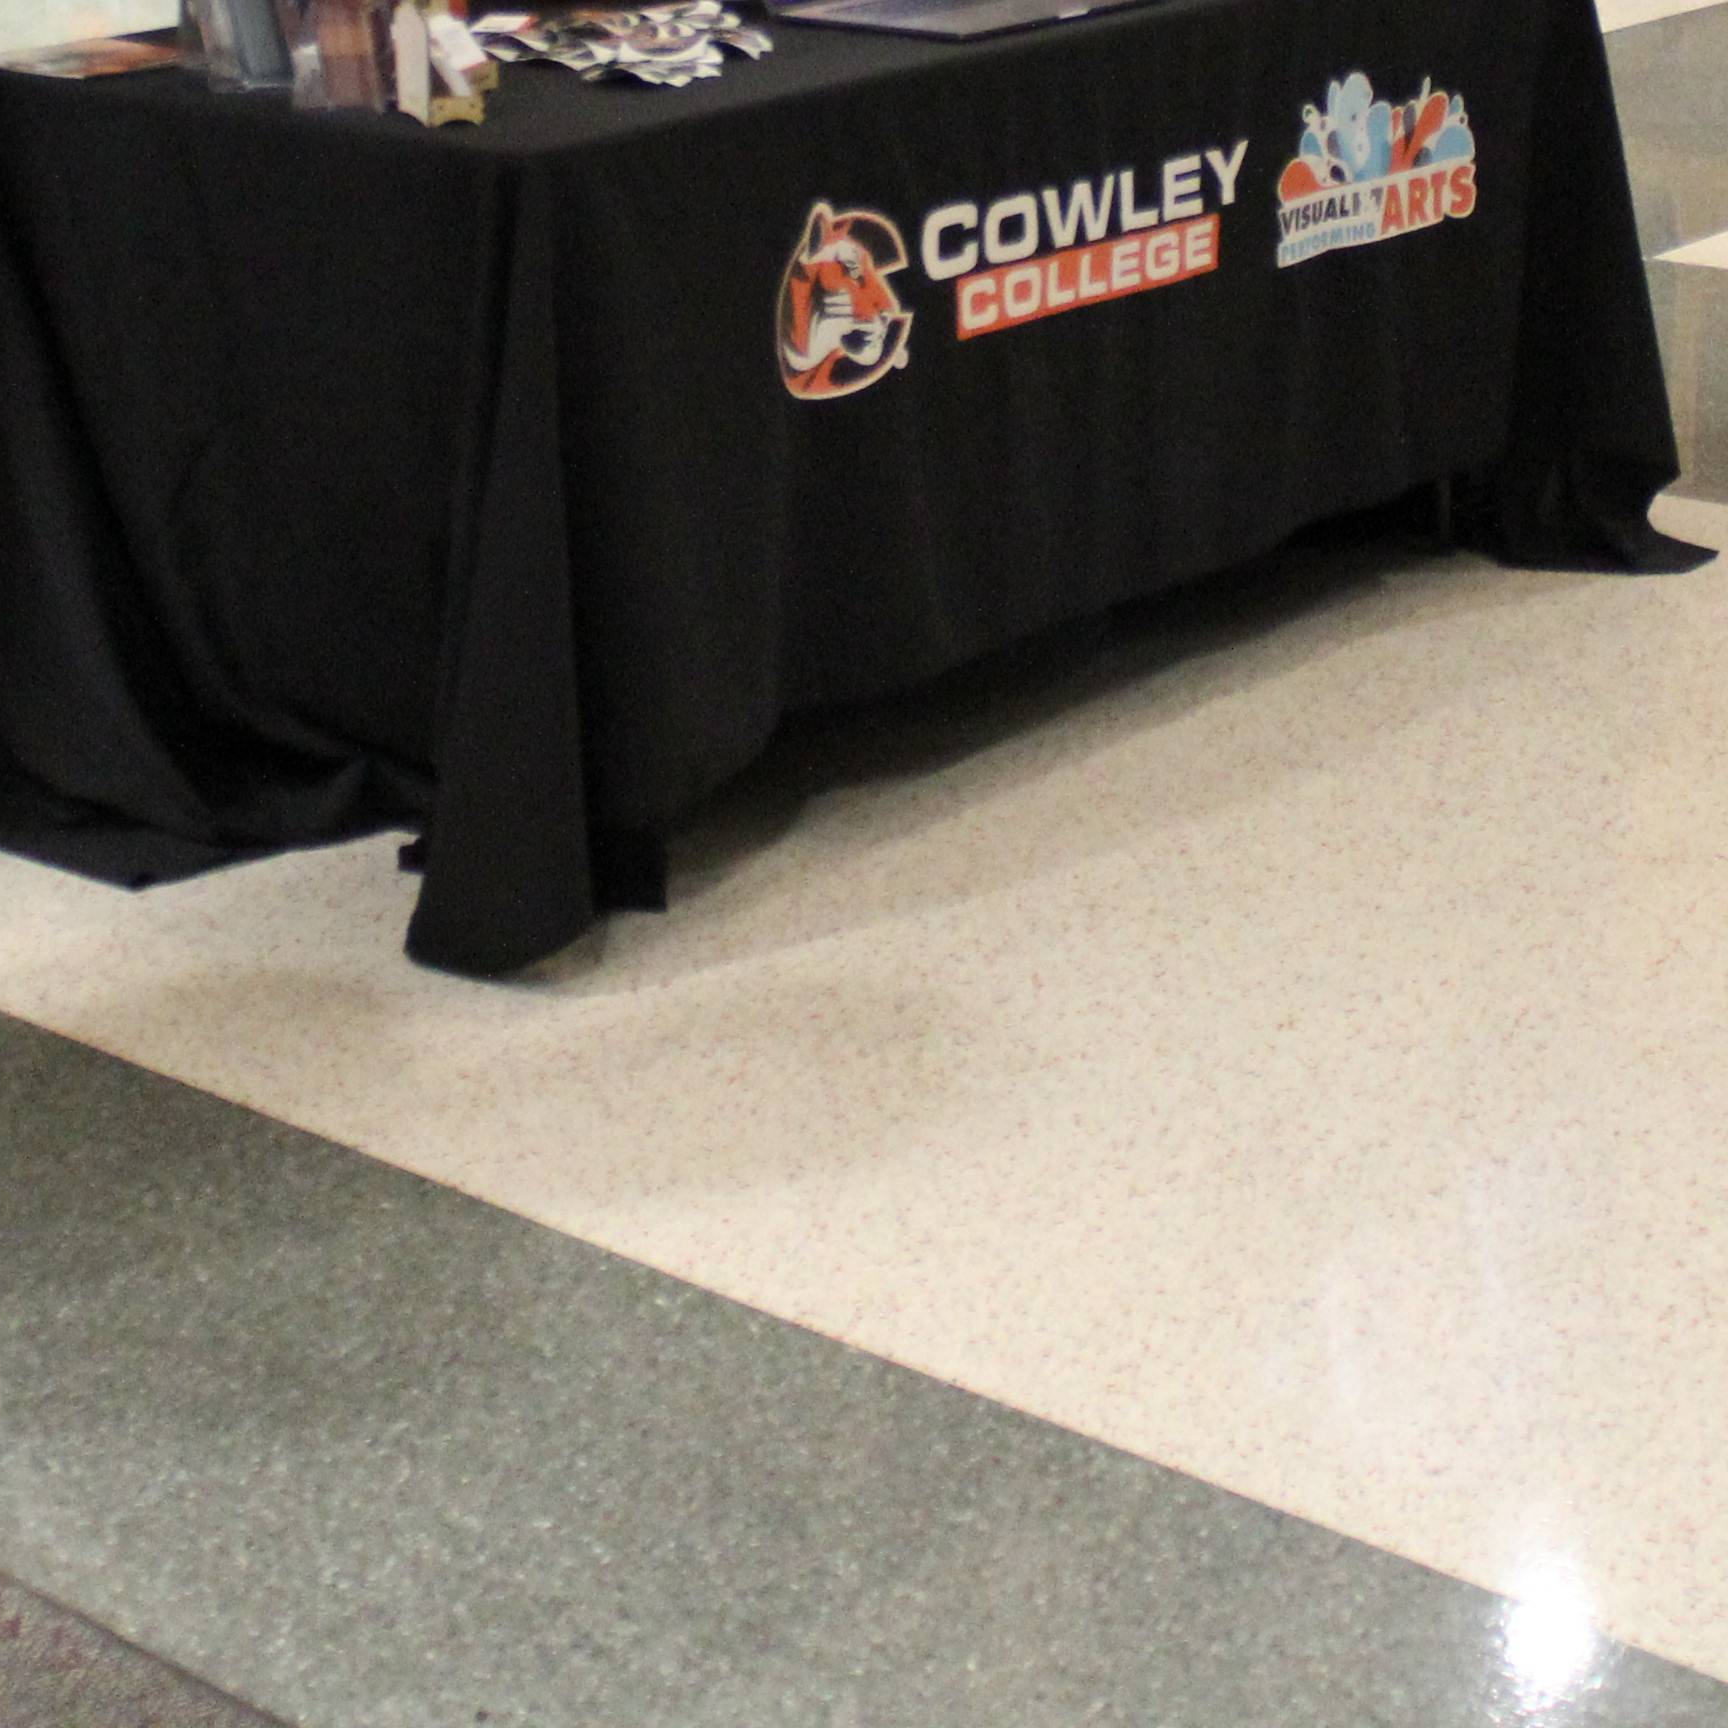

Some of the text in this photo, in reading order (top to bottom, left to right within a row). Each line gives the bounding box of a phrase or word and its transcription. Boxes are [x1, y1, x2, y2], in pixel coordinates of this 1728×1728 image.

[921, 139, 1249, 281] COWLEY
[1280, 193, 1350, 235] VISUAL
[1381, 166, 1474, 234] ARTS
[961, 221, 1214, 331] COLLEGE
